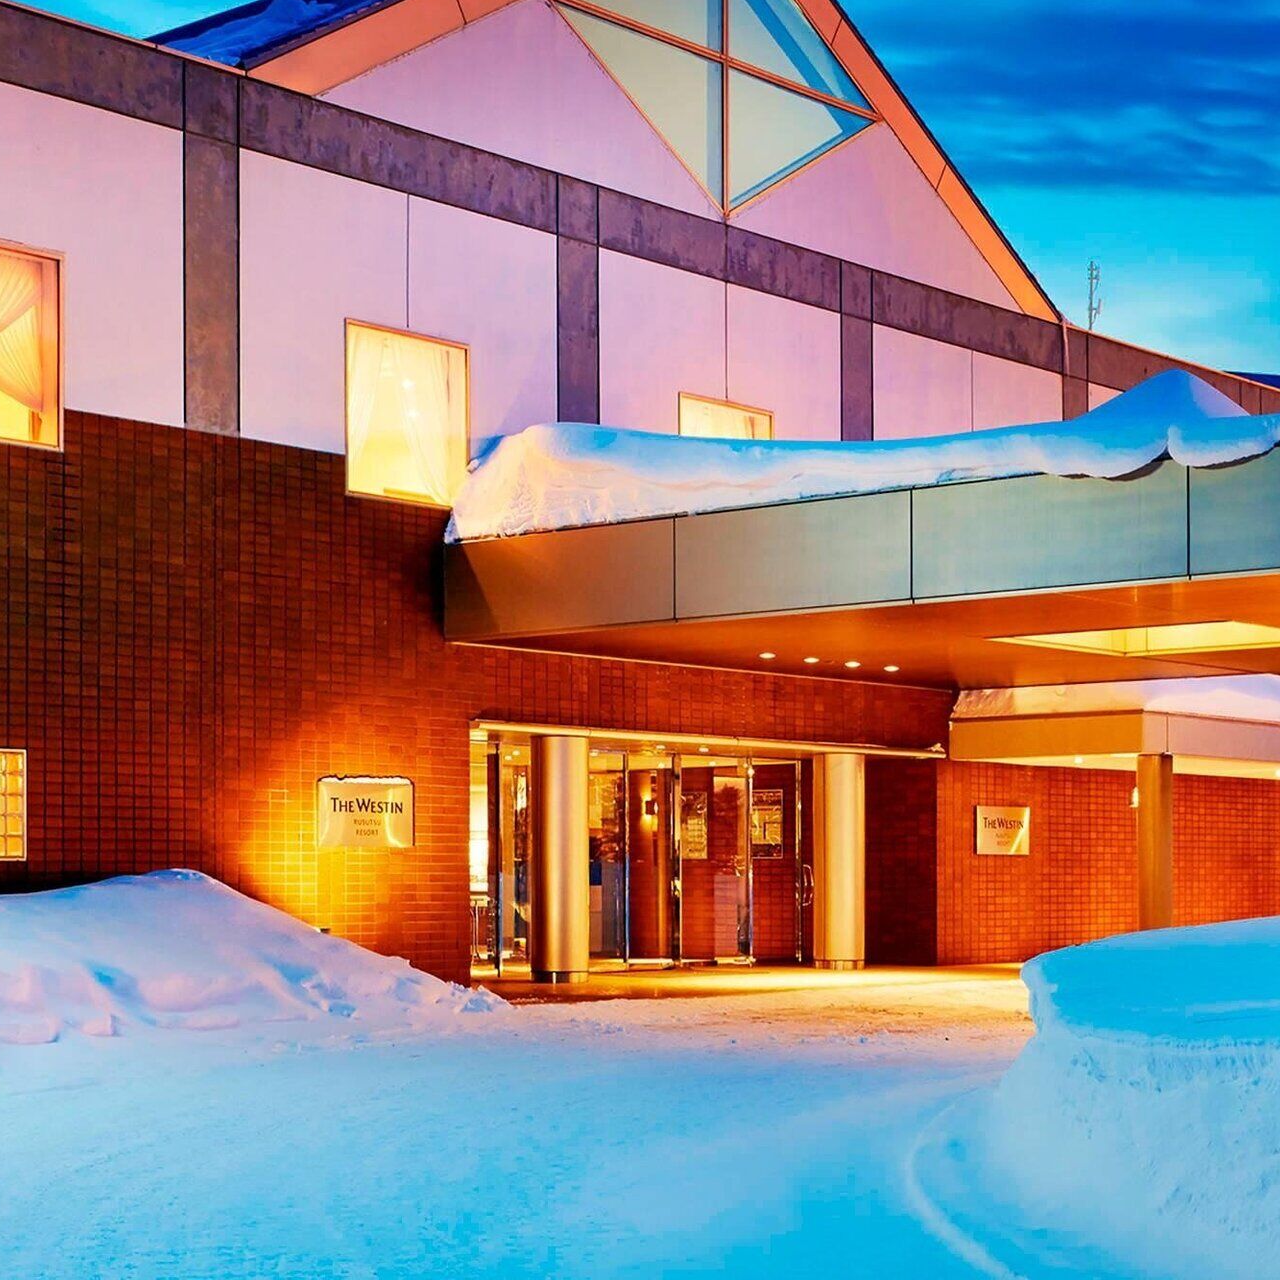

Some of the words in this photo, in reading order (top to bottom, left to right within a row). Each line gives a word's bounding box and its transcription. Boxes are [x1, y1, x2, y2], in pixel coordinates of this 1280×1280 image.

[330, 797, 355, 812] THE
[356, 798, 403, 814] WESTIN
[983, 817, 997, 829] THE
